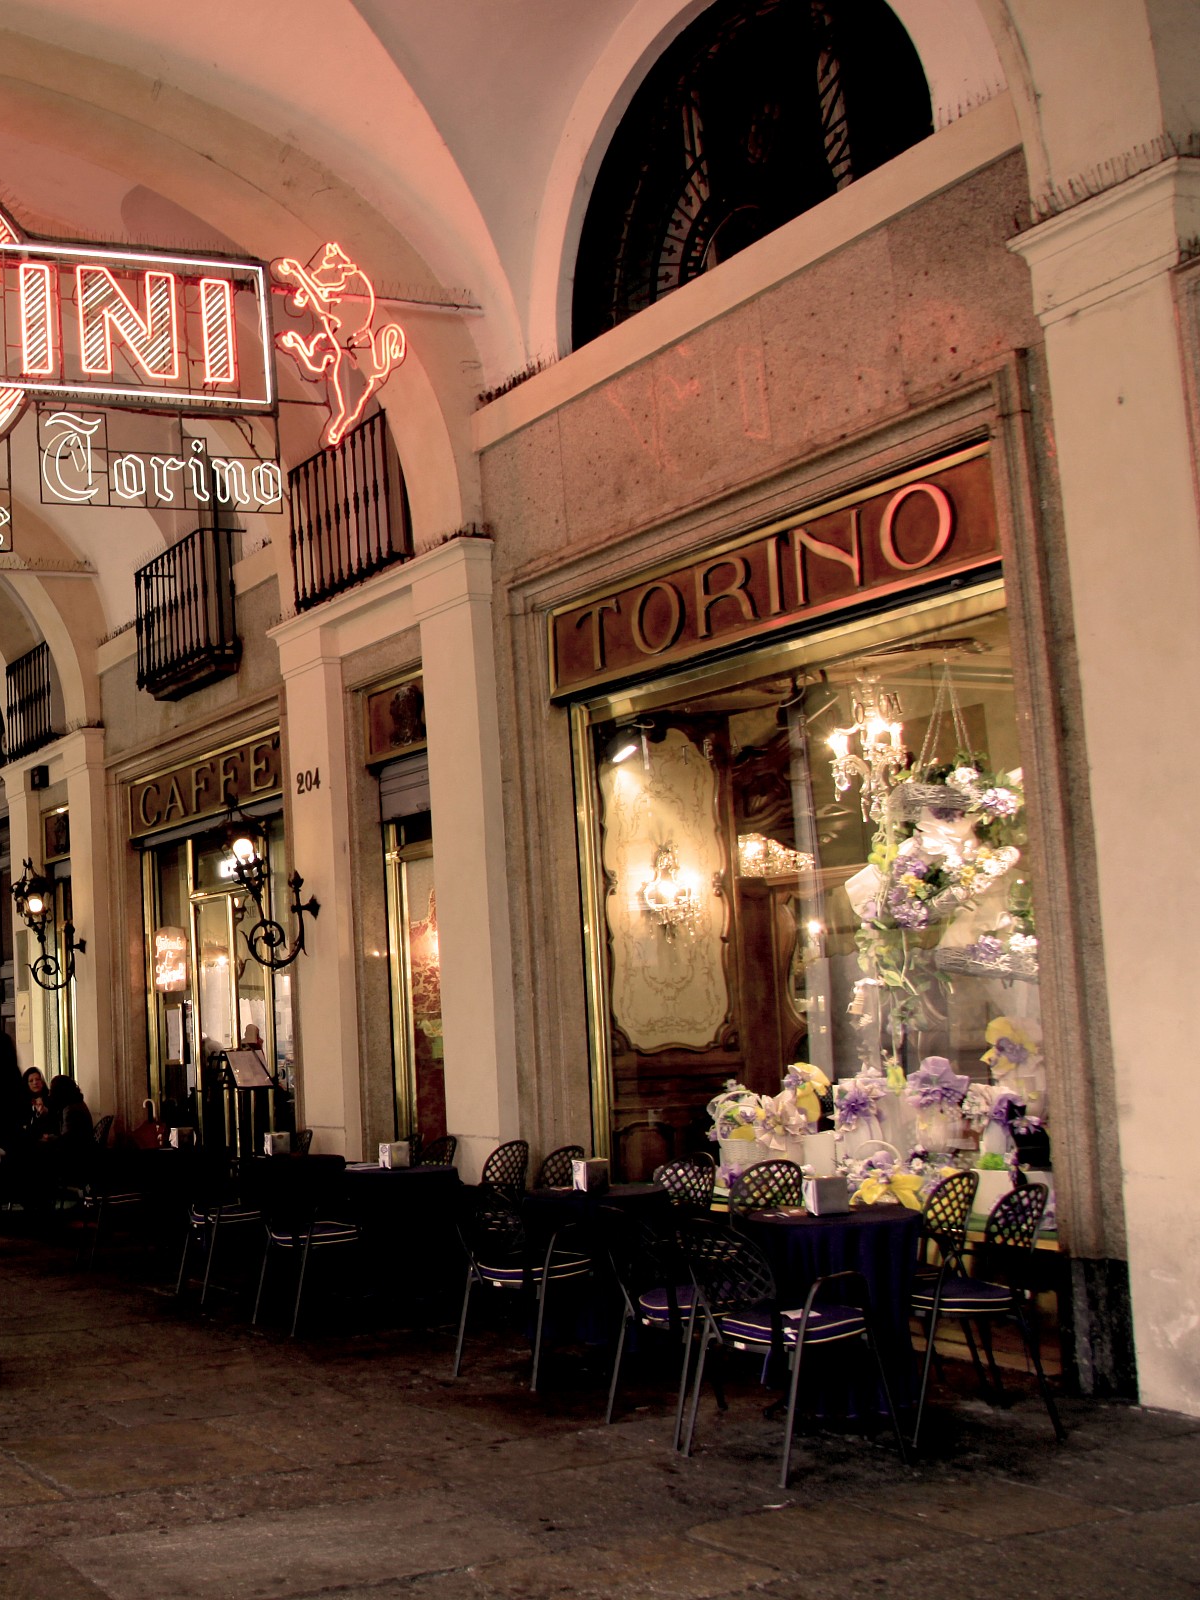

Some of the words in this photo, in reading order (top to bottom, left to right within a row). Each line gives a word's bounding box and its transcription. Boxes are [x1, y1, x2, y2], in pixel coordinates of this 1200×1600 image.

[43, 412, 282, 505] Torino
[575, 483, 954, 671] TORINO
[296, 767, 321, 794] 204
